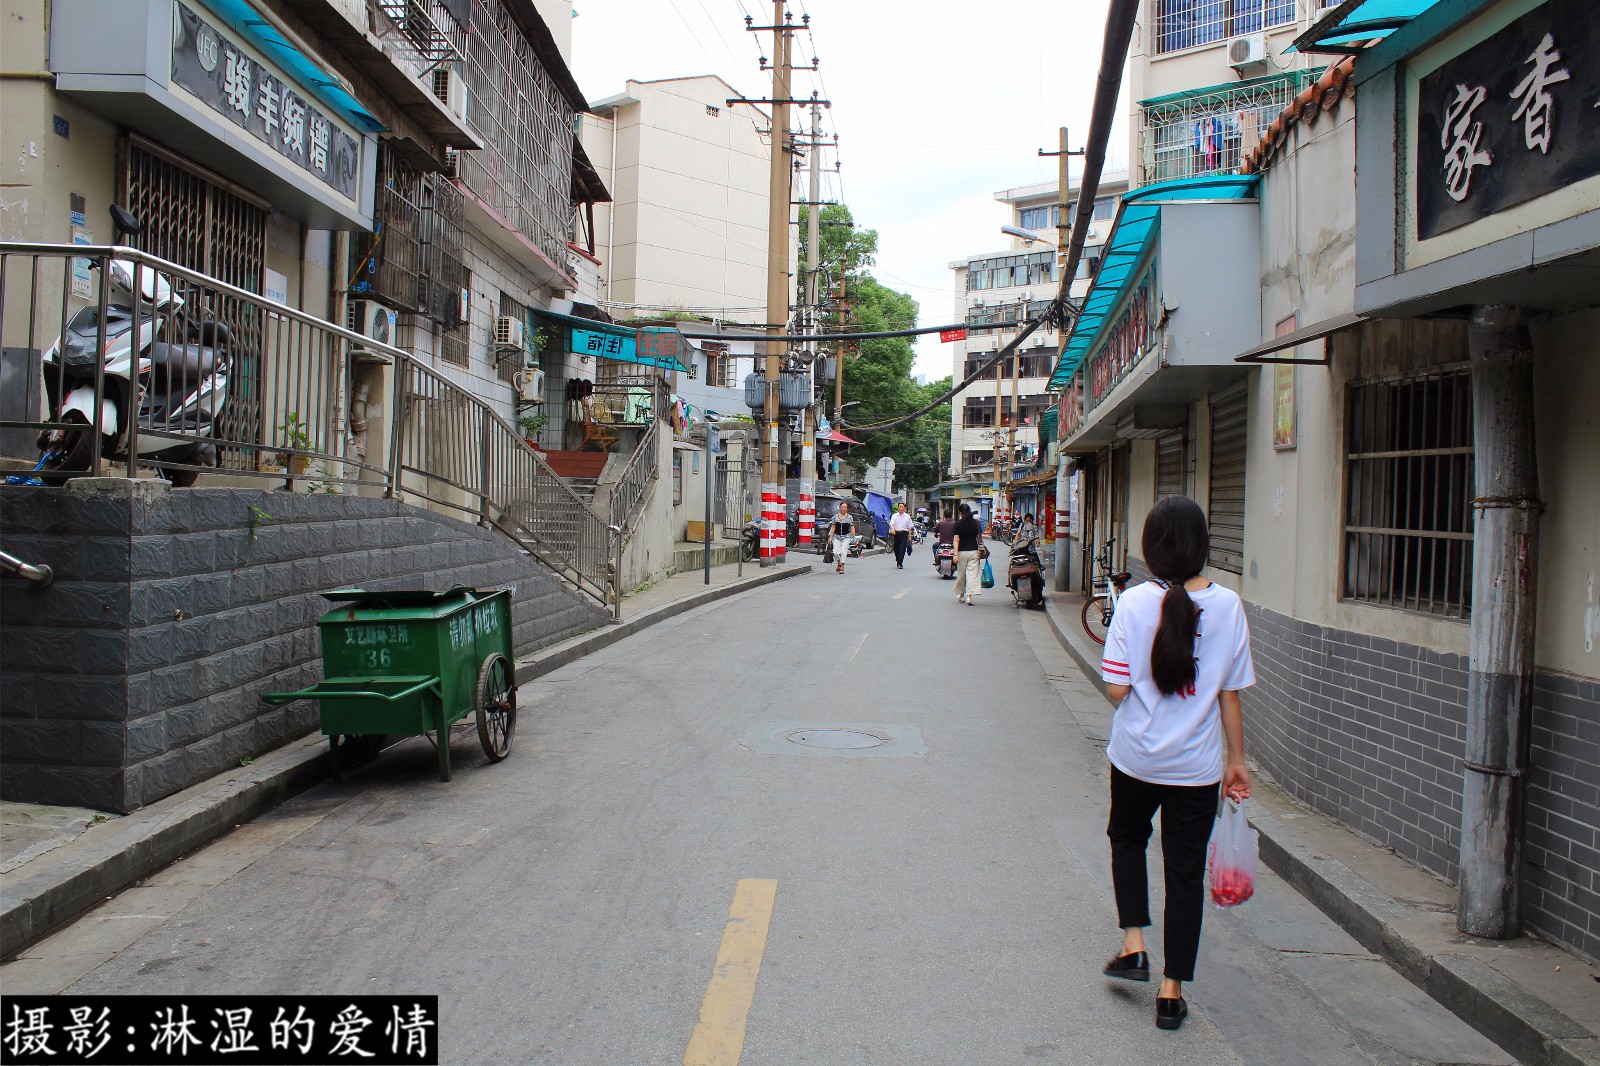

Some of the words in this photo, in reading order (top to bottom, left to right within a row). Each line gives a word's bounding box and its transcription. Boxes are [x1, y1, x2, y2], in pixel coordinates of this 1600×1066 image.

[198, 33, 218, 65] JFC
[224, 48, 330, 173] 骏丰频谱
[1440, 32, 1600, 203] 家香
[636, 332, 679, 356] 住宿
[344, 624, 408, 645] 文艺路环卫所
[366, 648, 391, 668] 36
